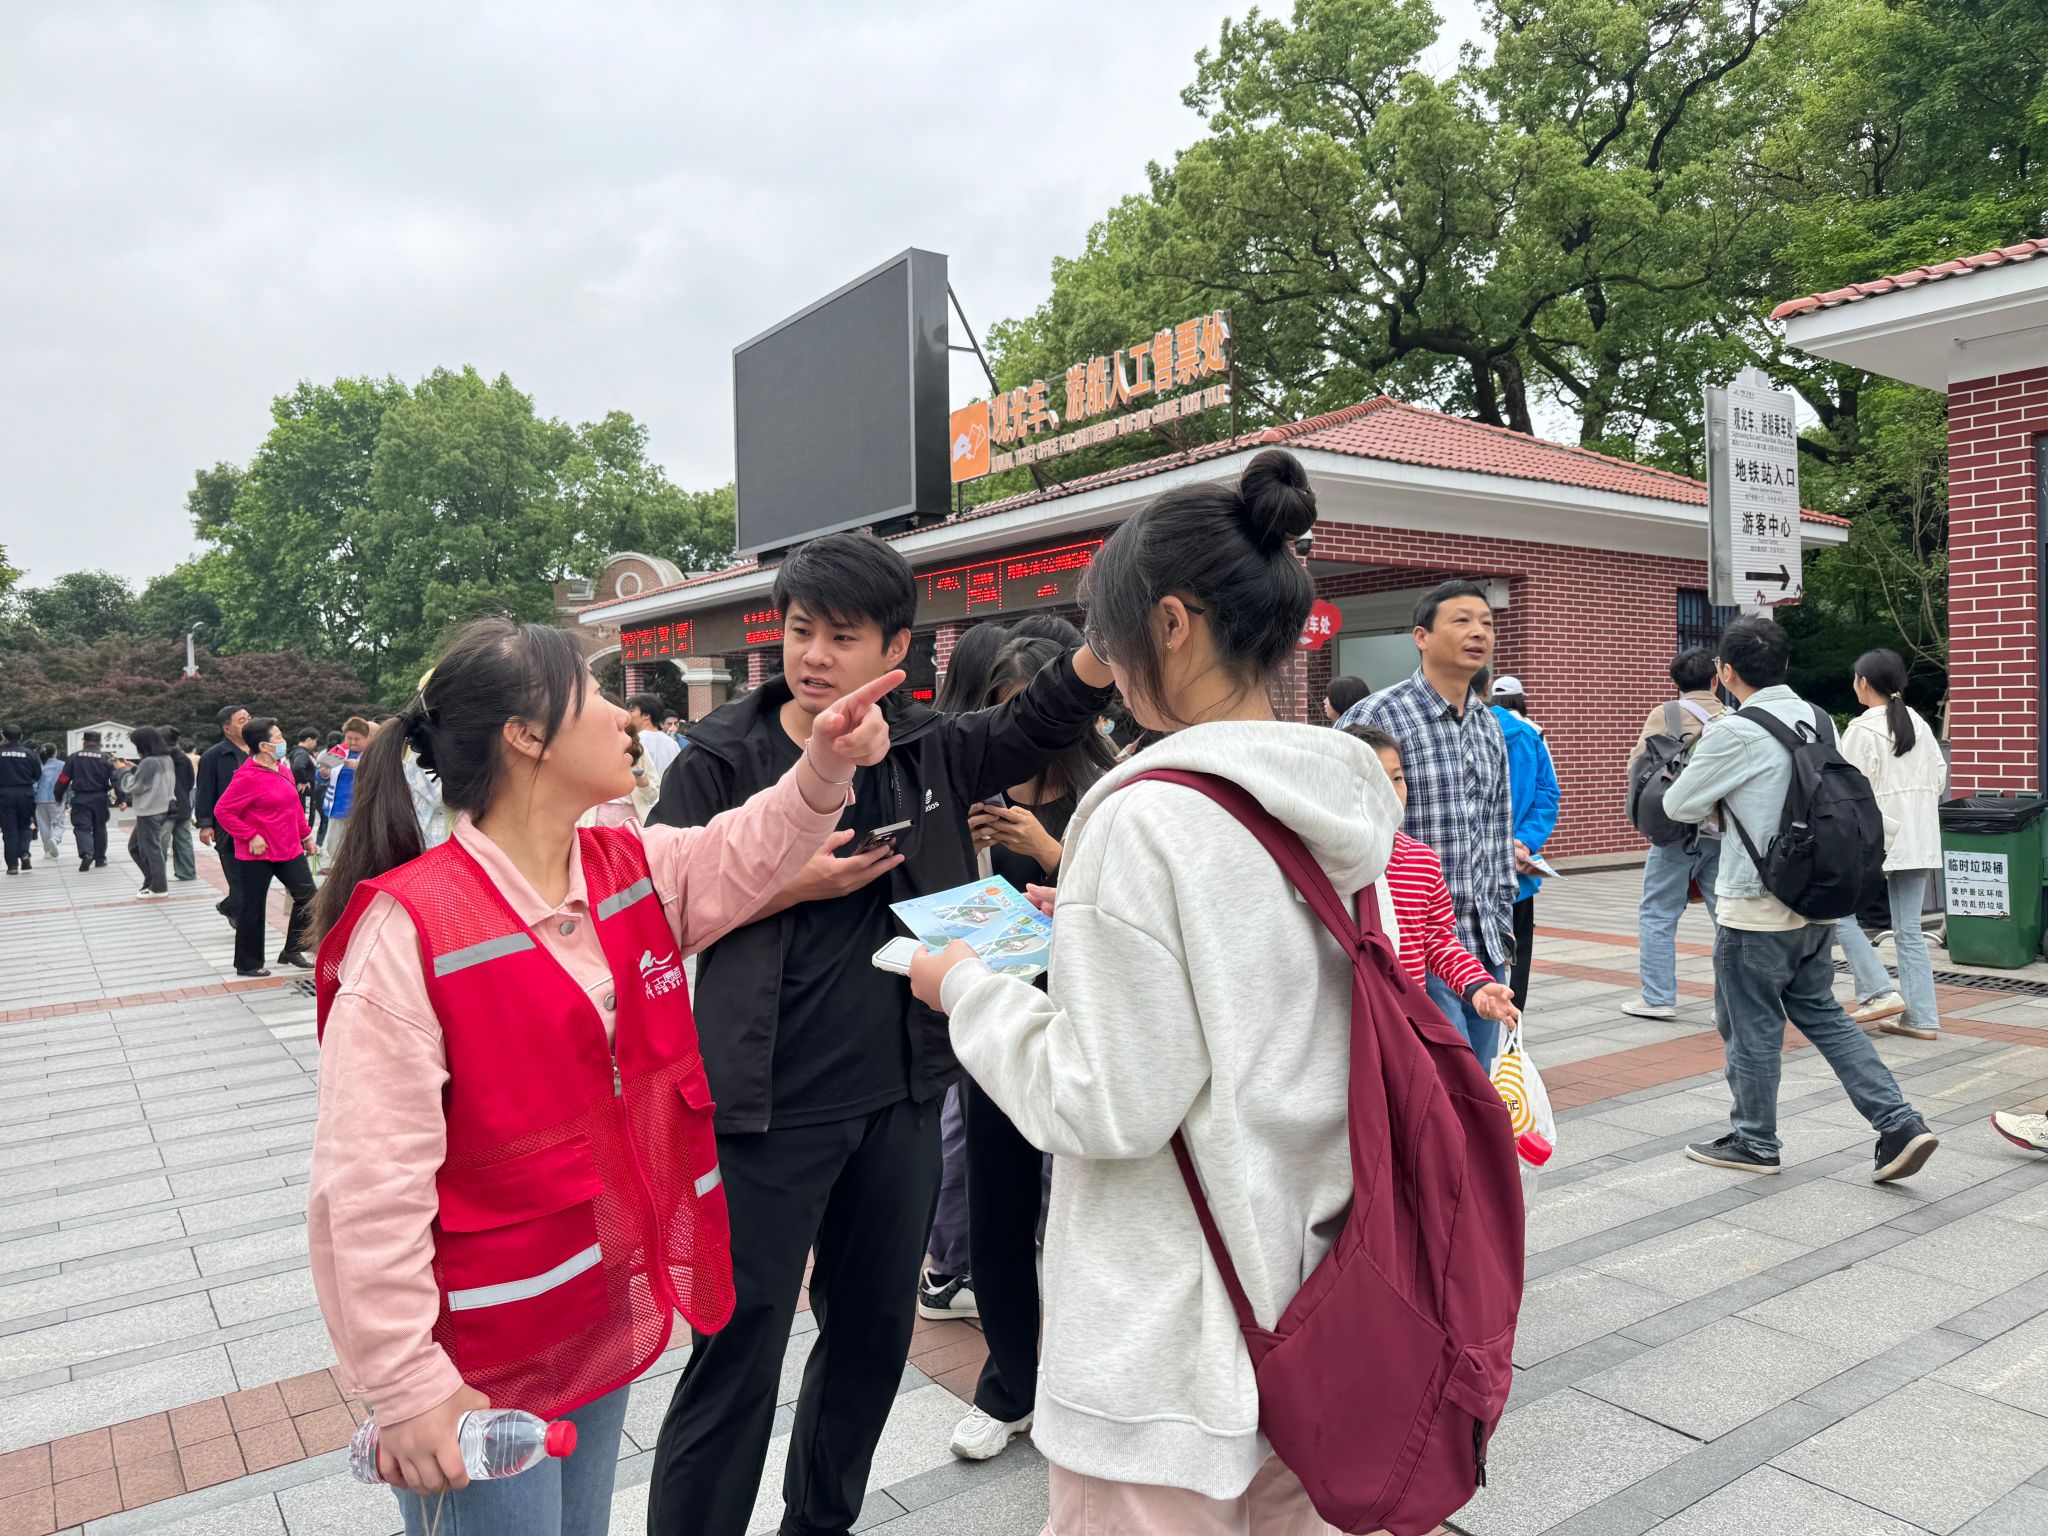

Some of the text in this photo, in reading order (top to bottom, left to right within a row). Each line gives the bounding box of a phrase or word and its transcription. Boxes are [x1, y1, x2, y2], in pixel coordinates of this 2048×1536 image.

[990, 309, 1230, 444] 观光车、游船人工售票处
[1735, 458, 1795, 487] 地铁站入口
[1742, 511, 1791, 538] 游客中心
[1948, 858, 2003, 875] 临时垃圾桶
[1952, 887, 2003, 898] 爱护景区环境
[1952, 899, 2004, 910] 请勿乱扔垃圾
